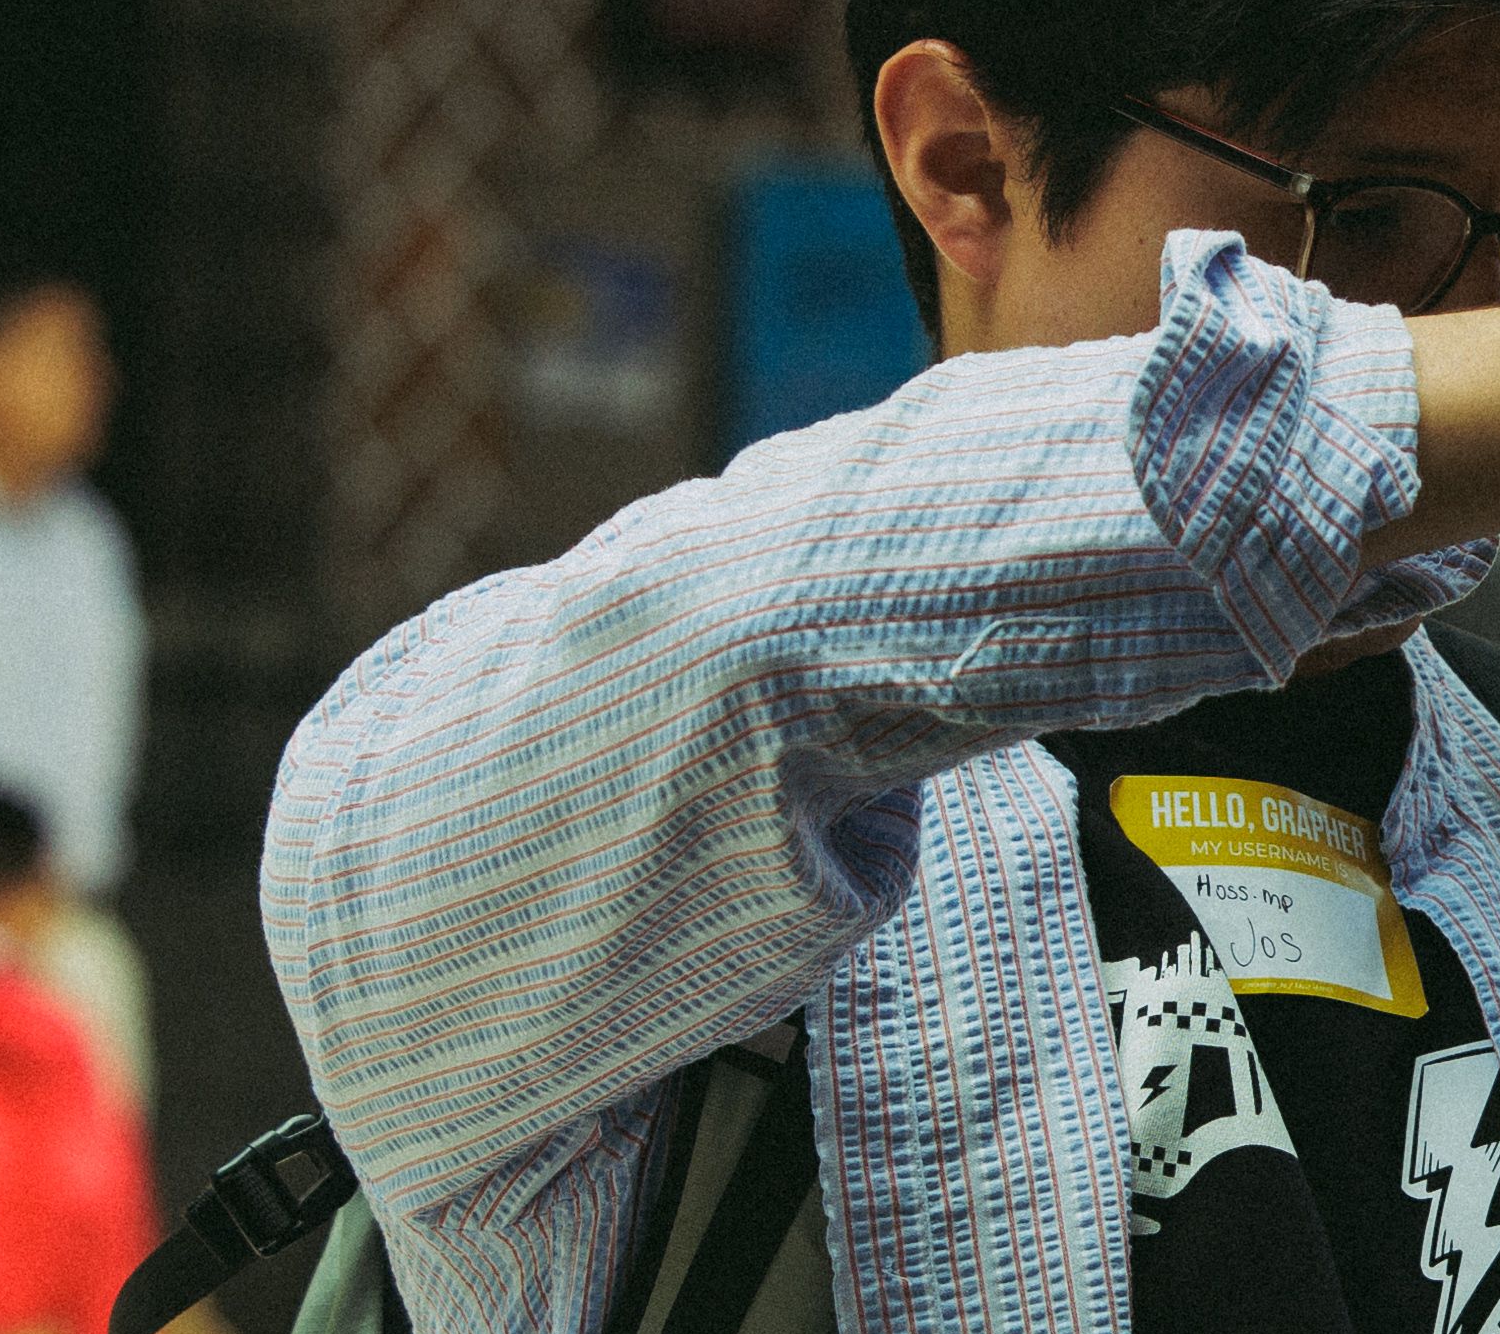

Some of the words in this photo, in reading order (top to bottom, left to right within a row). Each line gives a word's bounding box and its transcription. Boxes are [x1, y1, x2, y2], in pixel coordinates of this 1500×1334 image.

[1151, 791, 1257, 834] HELLO,
[1261, 797, 1367, 861] GRAPHER
[1191, 841, 1222, 856] MY
[1229, 841, 1331, 873] USERNAME
[1334, 861, 1349, 879] IS
